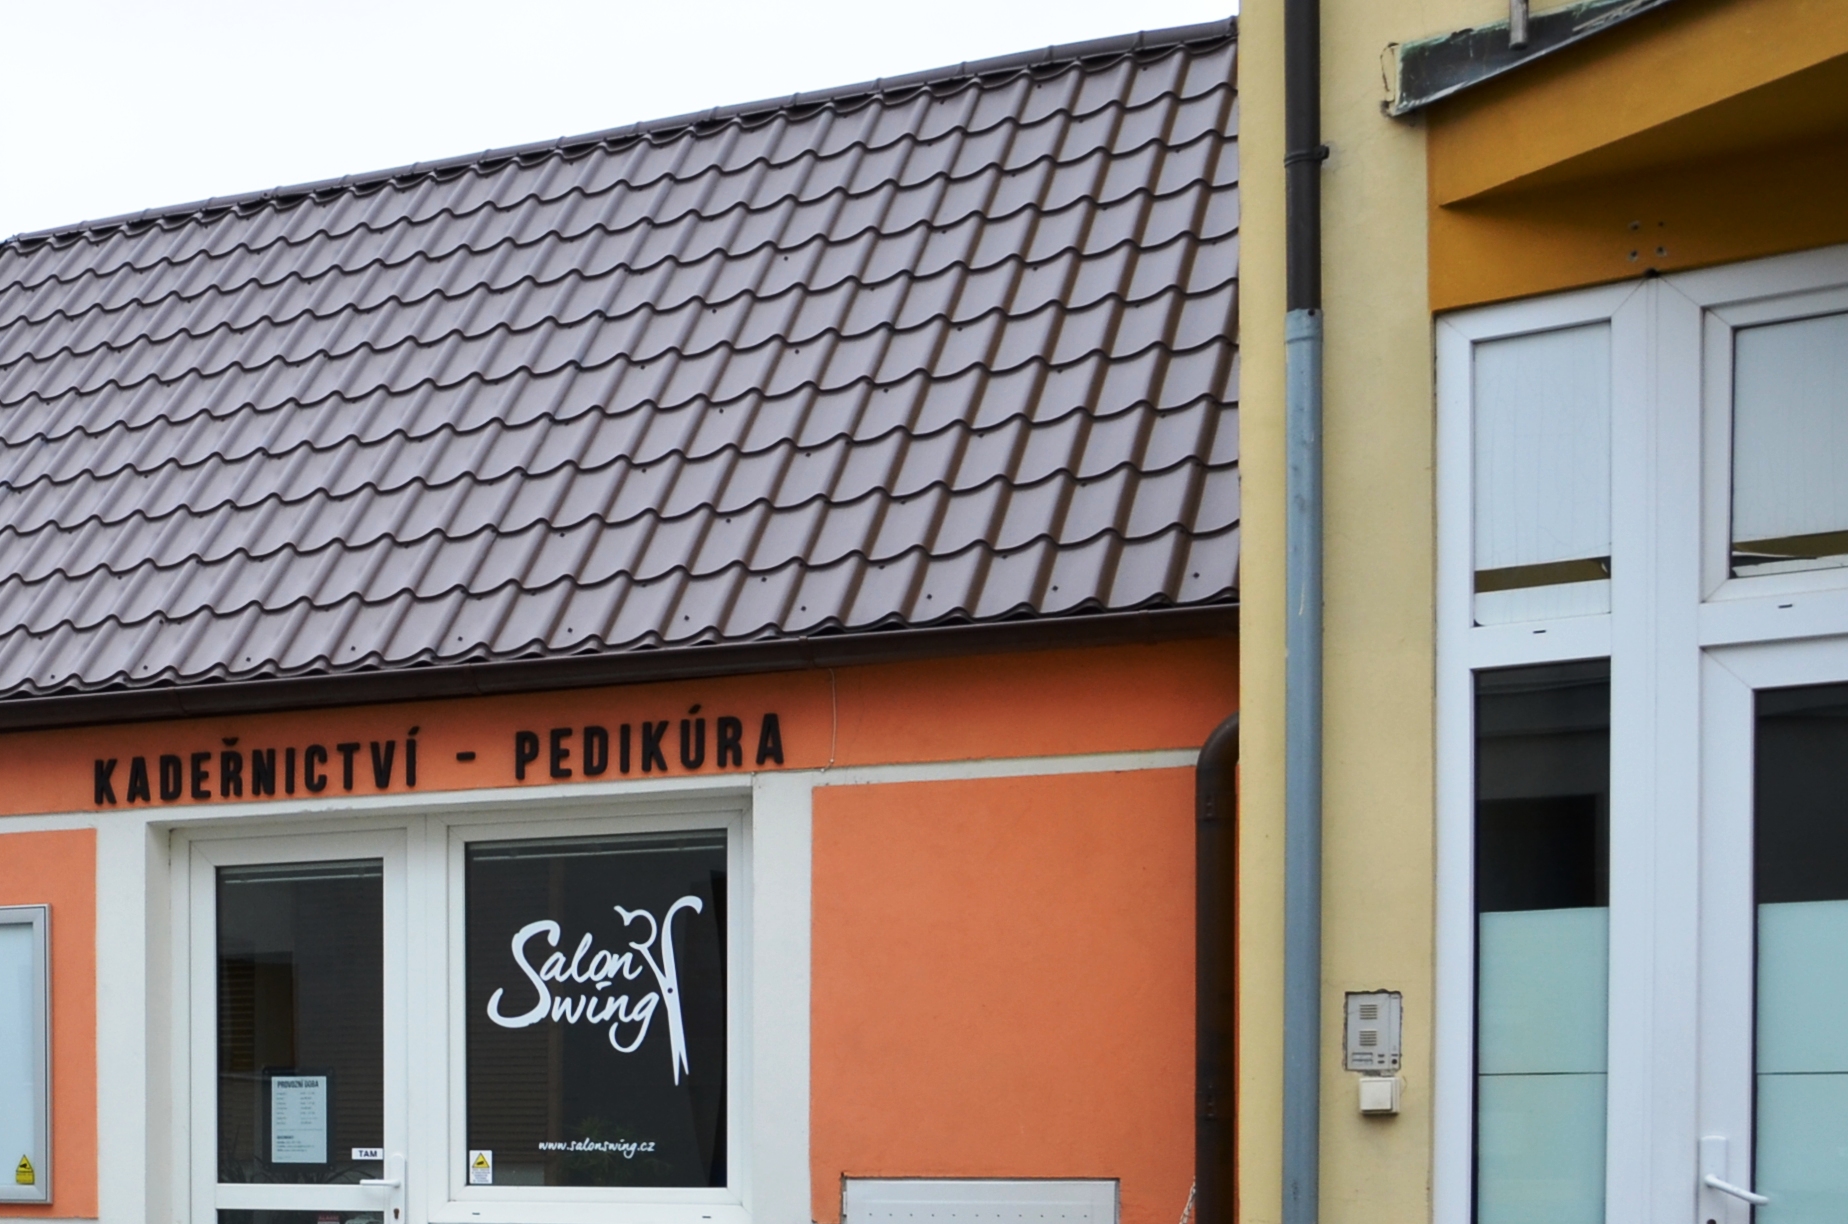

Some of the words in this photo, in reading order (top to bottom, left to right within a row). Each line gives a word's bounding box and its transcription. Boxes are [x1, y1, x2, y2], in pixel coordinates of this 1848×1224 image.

[93, 726, 420, 806] KADEŘNICTVÍ
[514, 704, 785, 781] PEDIKÚRA
[358, 1150, 378, 1159] TAM
[538, 1137, 656, 1159] www.salonswing.cz
